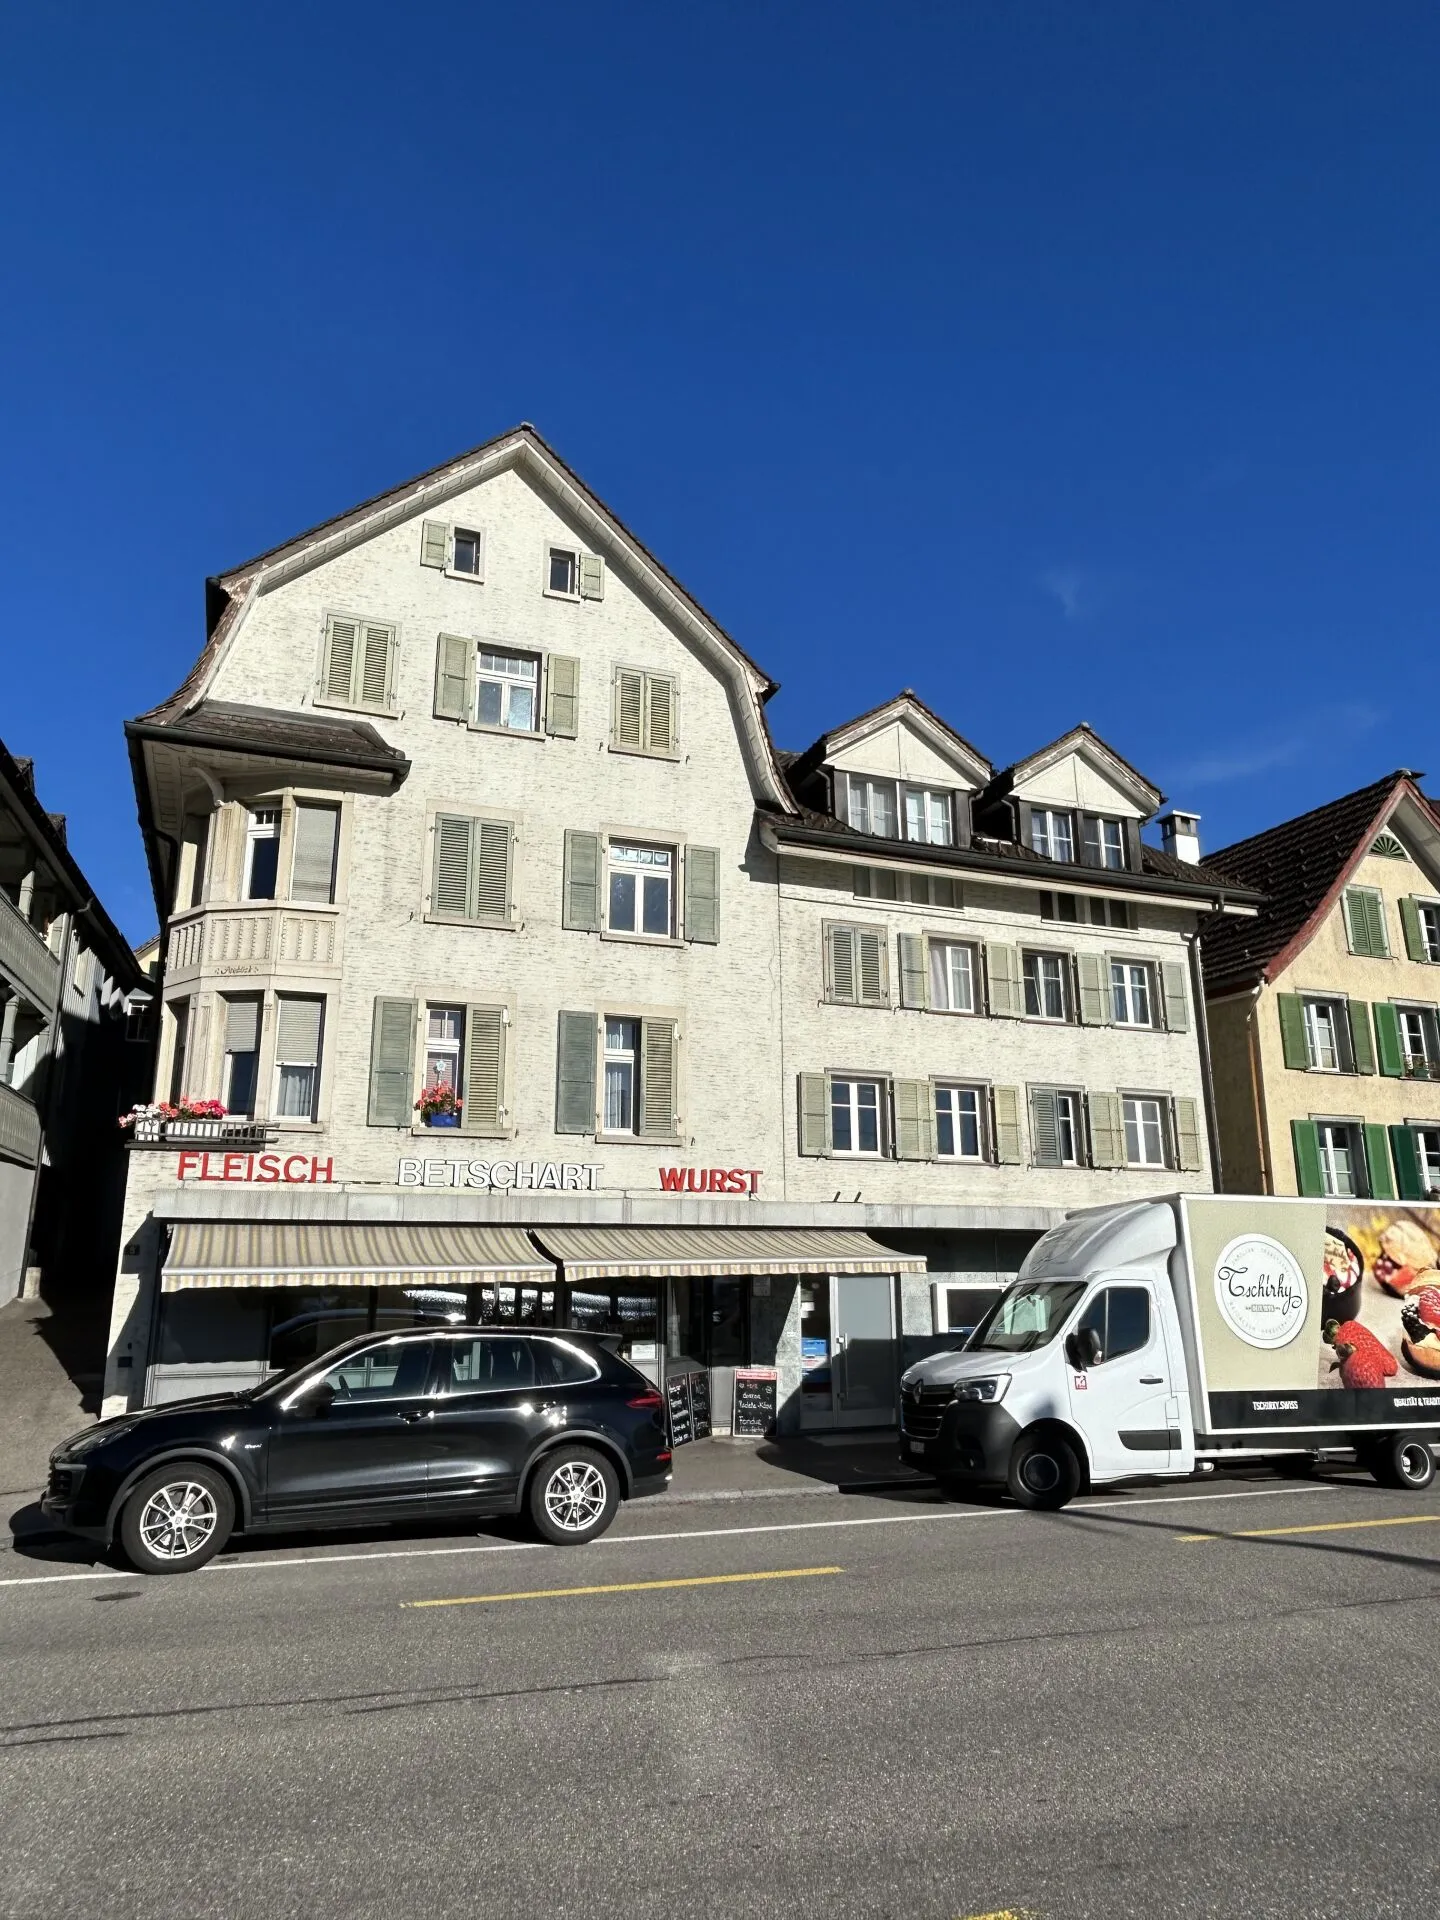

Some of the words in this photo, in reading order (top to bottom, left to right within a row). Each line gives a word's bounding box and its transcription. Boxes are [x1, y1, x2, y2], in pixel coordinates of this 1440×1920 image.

[177, 1151, 334, 1184] FLEISCH
[397, 1158, 604, 1191] BETSCHART
[658, 1167, 764, 1194] WURST
[1218, 1266, 1303, 1316] Tschirky
